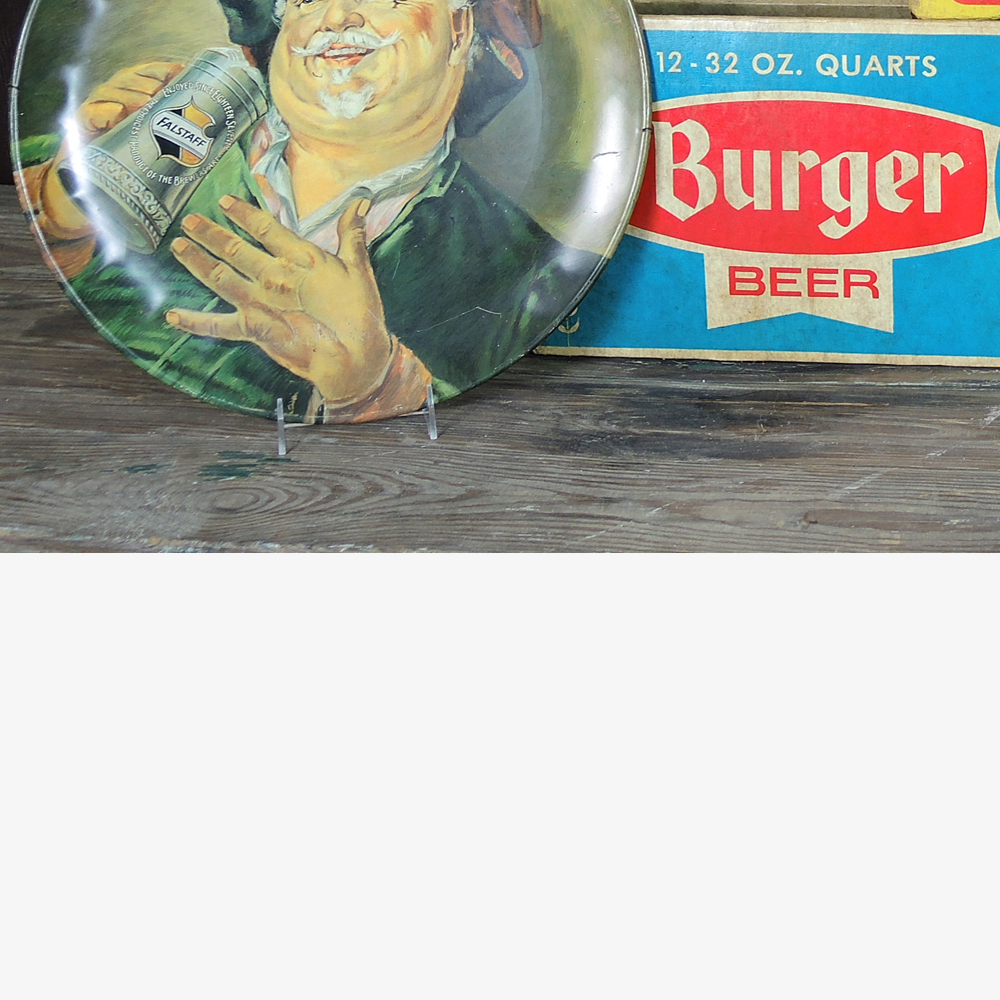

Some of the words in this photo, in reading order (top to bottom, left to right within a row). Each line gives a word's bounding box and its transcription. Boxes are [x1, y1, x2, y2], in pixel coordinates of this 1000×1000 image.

[751, 51, 803, 76] OZ.
[815, 53, 938, 79] QUARTS
[211, 88, 236, 121] EIGHTEEN
[156, 116, 208, 149] FALSTAFF
[146, 169, 158, 180] OF
[158, 174, 173, 186] THE
[652, 118, 966, 240] Burger
[728, 264, 880, 300] BEER
